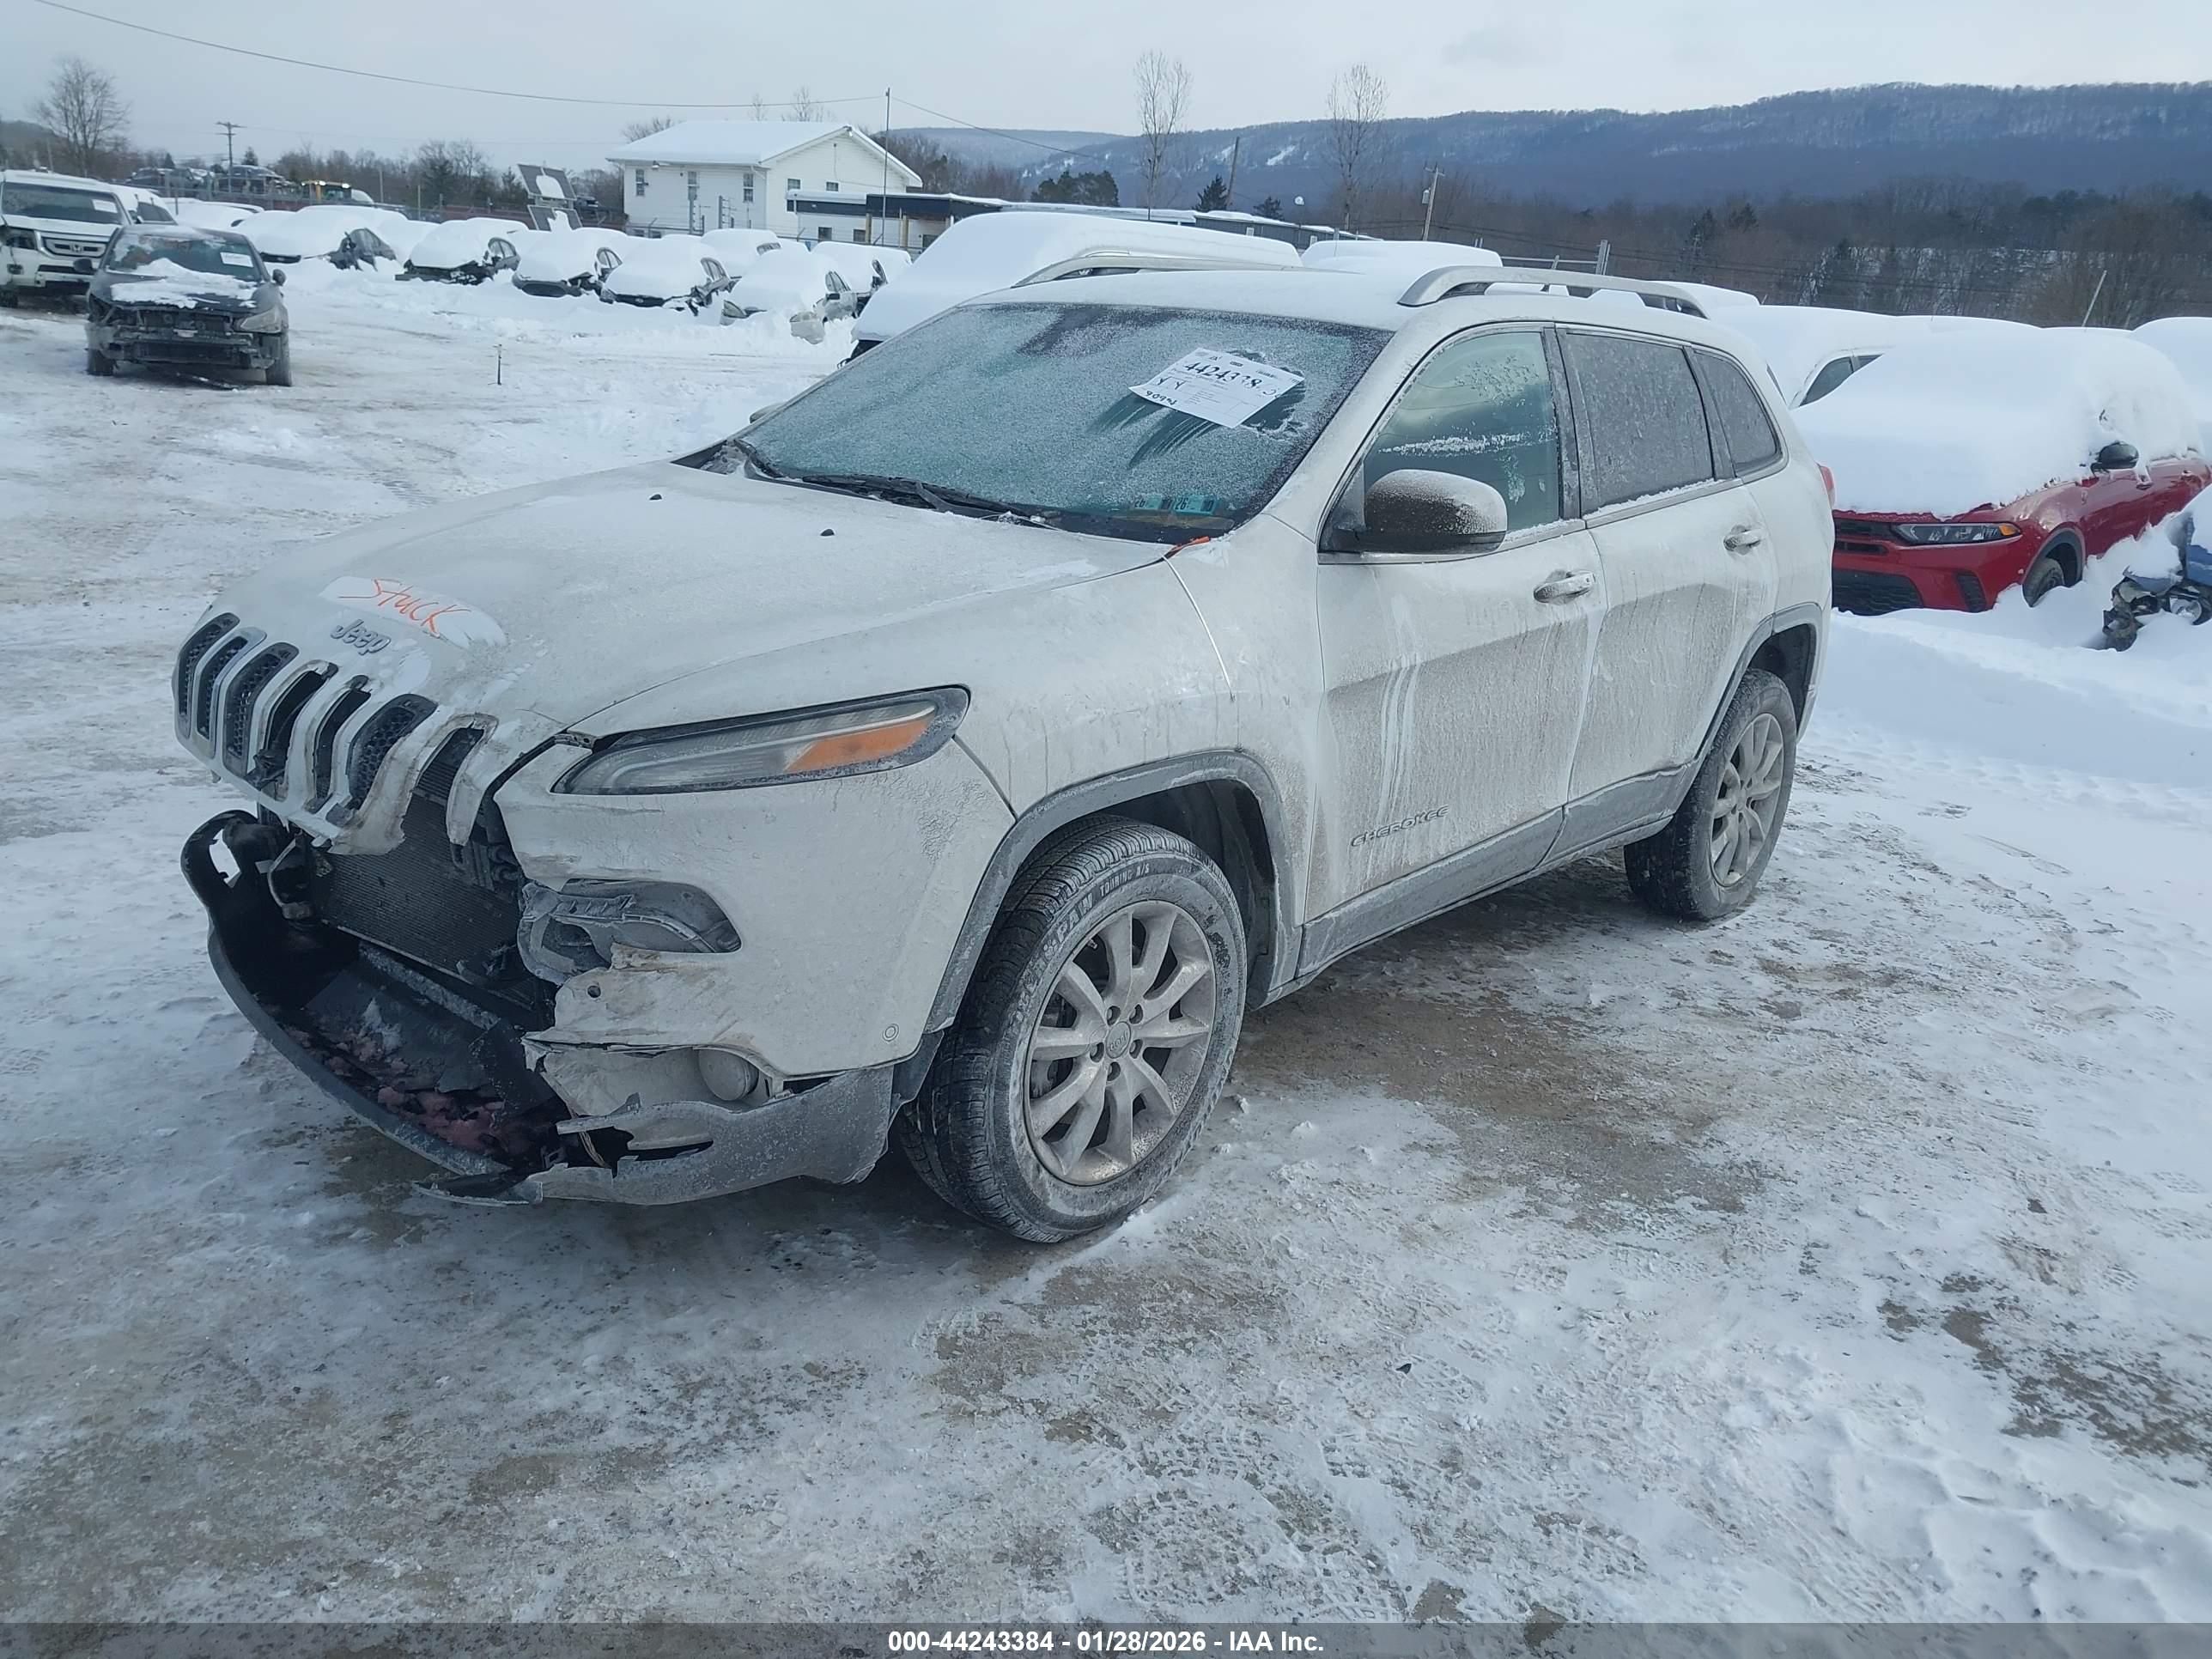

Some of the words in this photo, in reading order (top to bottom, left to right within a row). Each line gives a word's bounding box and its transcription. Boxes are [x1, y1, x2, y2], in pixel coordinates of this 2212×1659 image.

[330, 618, 392, 656] Jeep
[1351, 804, 1449, 847] CHEROKEE
[1056, 892, 1094, 944] PAW
[1099, 867, 1133, 897] TOURING
